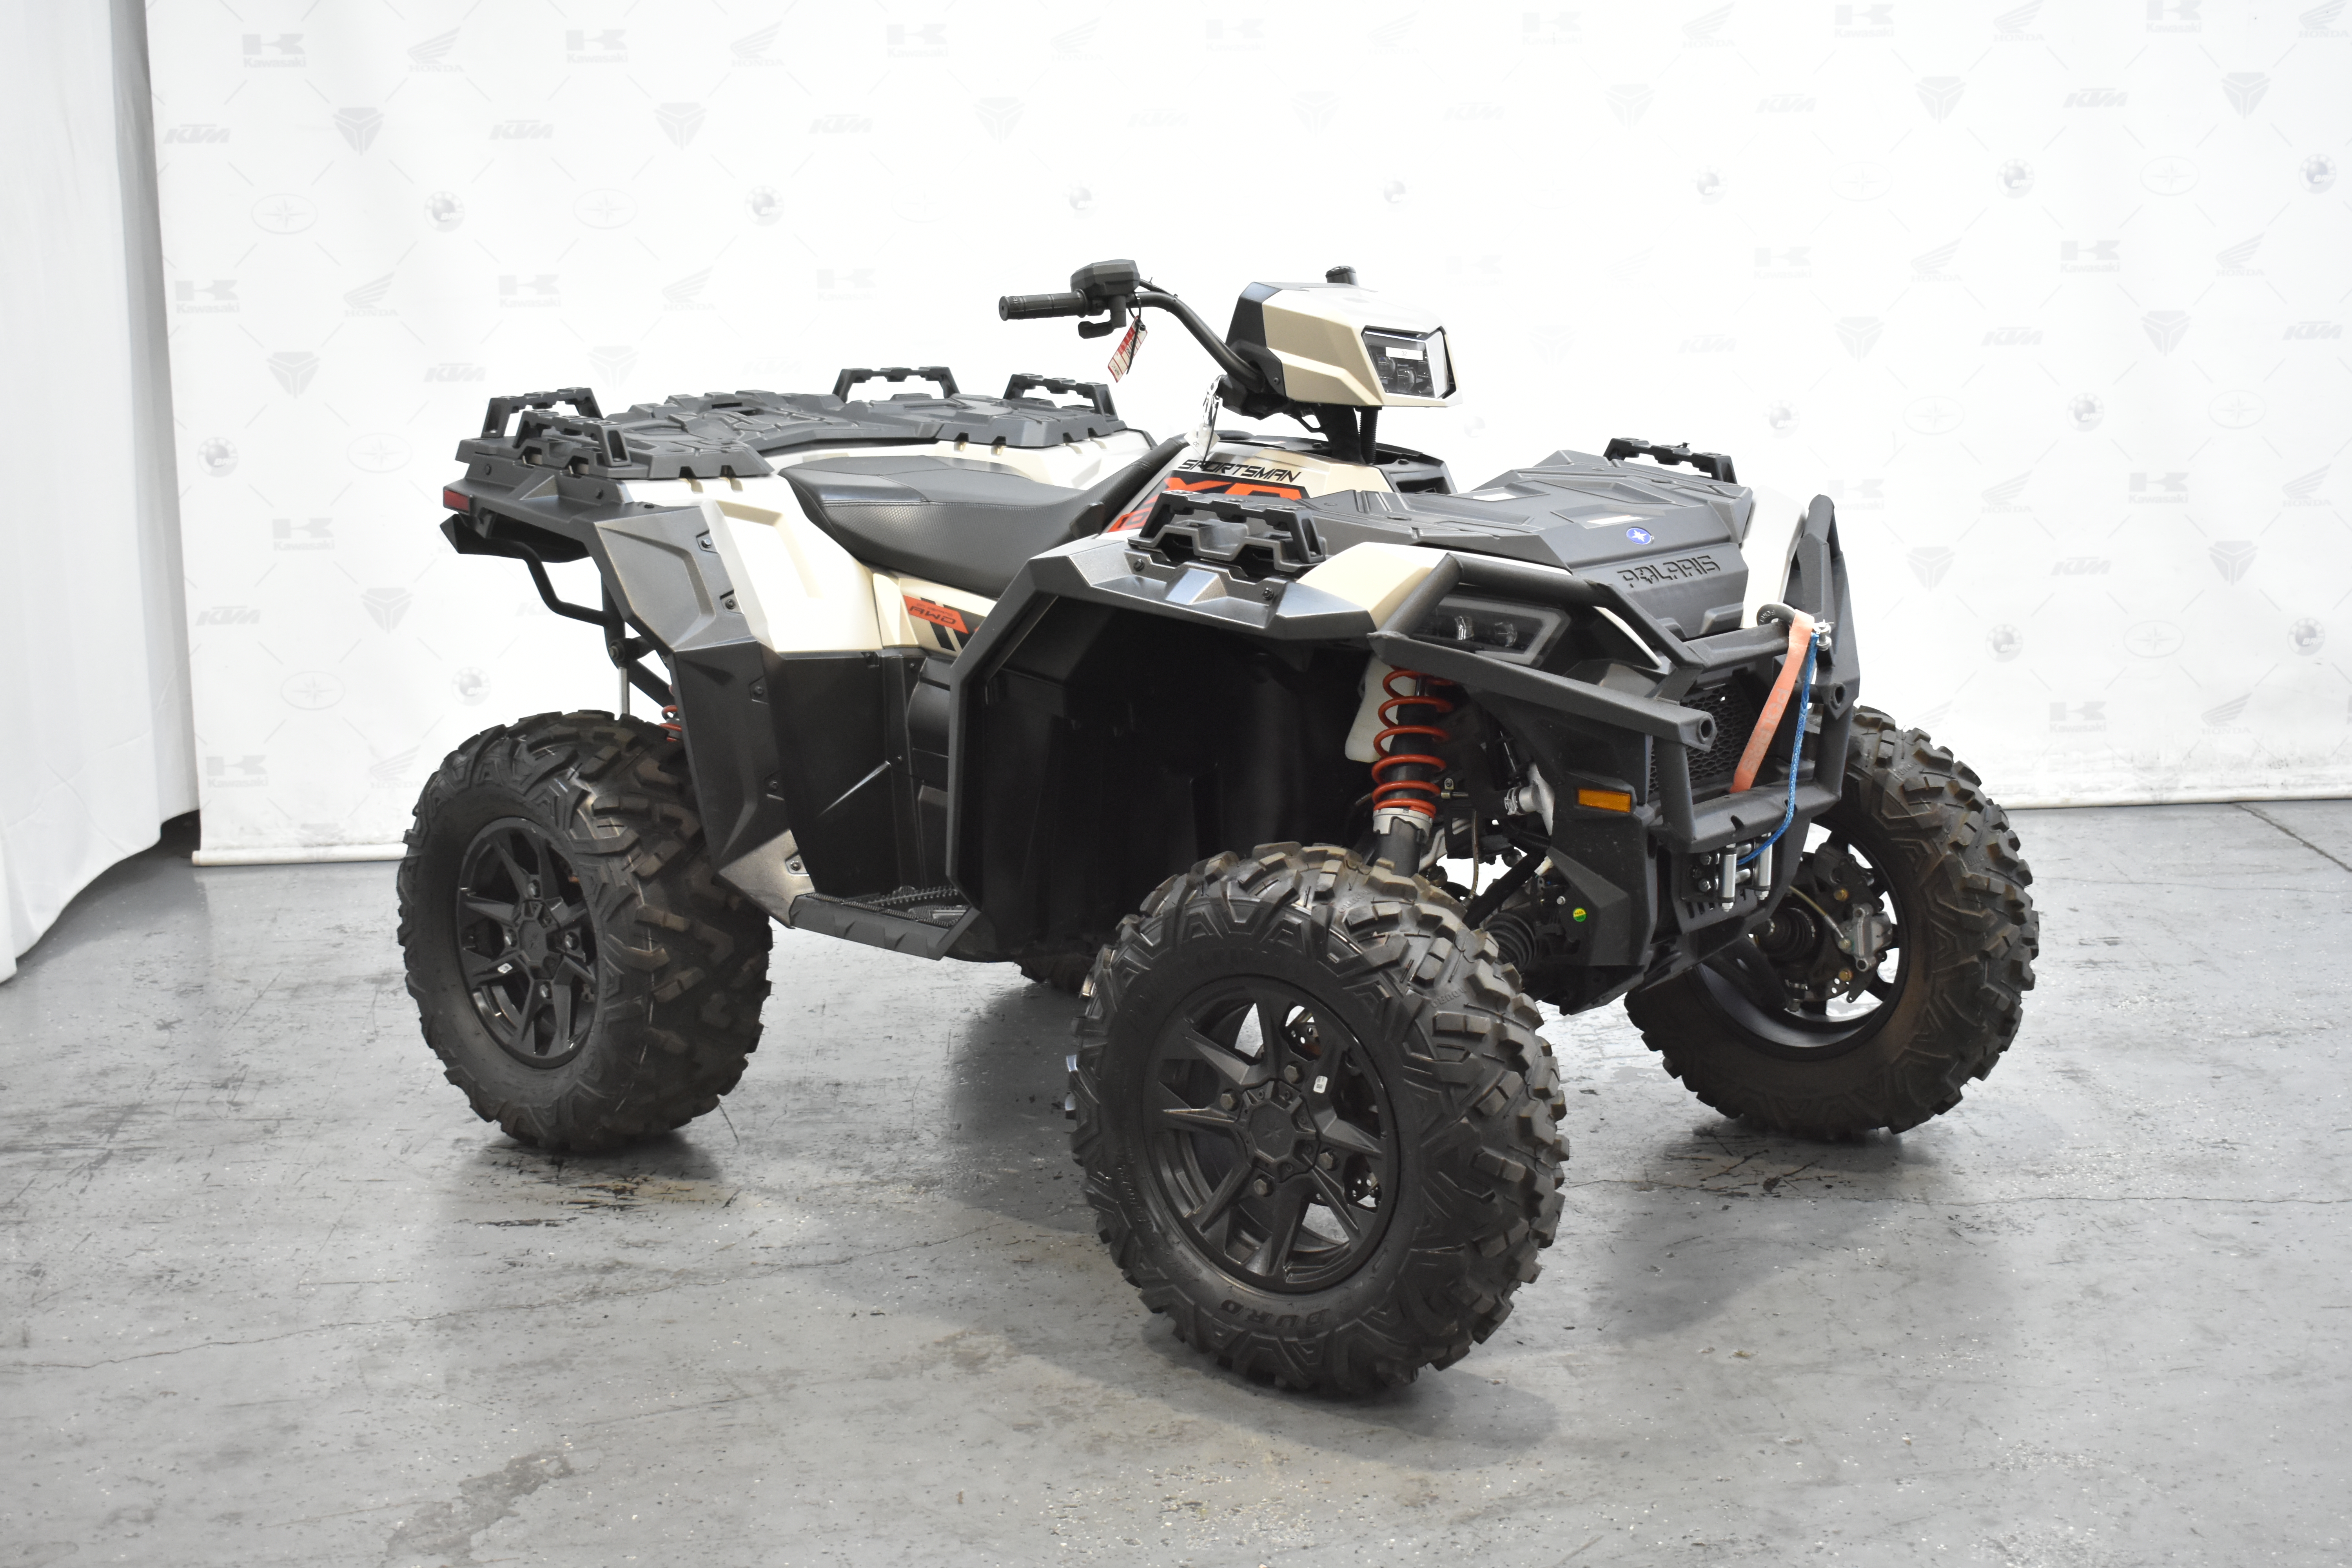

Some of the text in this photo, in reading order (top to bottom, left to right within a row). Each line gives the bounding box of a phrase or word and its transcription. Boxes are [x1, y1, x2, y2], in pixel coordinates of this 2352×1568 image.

[1835, 27, 1895, 38] Kawasaki
[2146, 22, 2202, 33] Kawasaki
[1993, 33, 2045, 42] HONDA
[2298, 30, 2350, 38] HONDA
[1522, 35, 1583, 45] Kawasaki
[887, 46, 949, 58] Kawasaki
[1206, 42, 1266, 52] Kawasaki
[243, 58, 307, 69] Kawasaki
[566, 53, 628, 64] Kawasaki
[731, 59, 785, 67] HONDA
[408, 64, 465, 73] HONDA
[1756, 94, 1817, 113] KTM
[2063, 88, 2128, 108] KTM
[1443, 102, 1505, 121] KTM
[808, 114, 873, 135] KTM
[1127, 109, 1189, 129] KTM
[163, 123, 231, 144] KTM
[489, 120, 554, 140] KTM
[1705, 185, 1726, 194] BRP
[2060, 262, 2120, 273] Kawasaki
[2216, 269, 2265, 277] HONDA
[1754, 269, 1812, 280] Kawasaki
[1910, 274, 1963, 283] HONDA
[1445, 277, 1503, 287] Kawasaki
[817, 291, 877, 302] Kawasaki
[176, 304, 240, 314] Kawasaki
[499, 298, 561, 309] Kawasaki
[663, 303, 716, 311] HONDA
[2283, 321, 2343, 341] KTM
[1981, 327, 2043, 347] KTM
[1678, 334, 1737, 352] KTM
[741, 357, 802, 376] KTM
[424, 363, 486, 383] KTM
[2081, 413, 2104, 421] BRP
[1777, 419, 1799, 428] BRP
[214, 458, 237, 466] BRP
[1178, 459, 1302, 483] SPORTSMAN
[2129, 494, 2189, 505] Kawasaki
[2282, 499, 2332, 507] HONDA
[1836, 500, 1885, 511] awasaki
[1981, 505, 2033, 514] HONDA
[274, 539, 335, 550] Kawasaki
[1617, 555, 1721, 588] POLARIS
[2051, 556, 2112, 576] KTM
[196, 606, 261, 626] KTM
[909, 606, 956, 625] AWD
[2000, 644, 2023, 652] BRP
[2302, 638, 2325, 647] BRP
[2049, 722, 2107, 734] Kawasaki
[2200, 727, 2251, 735] HONDA
[207, 775, 269, 788] Kawasaki
[370, 780, 423, 789] HONDA
[1219, 1299, 1329, 1329] DURO
